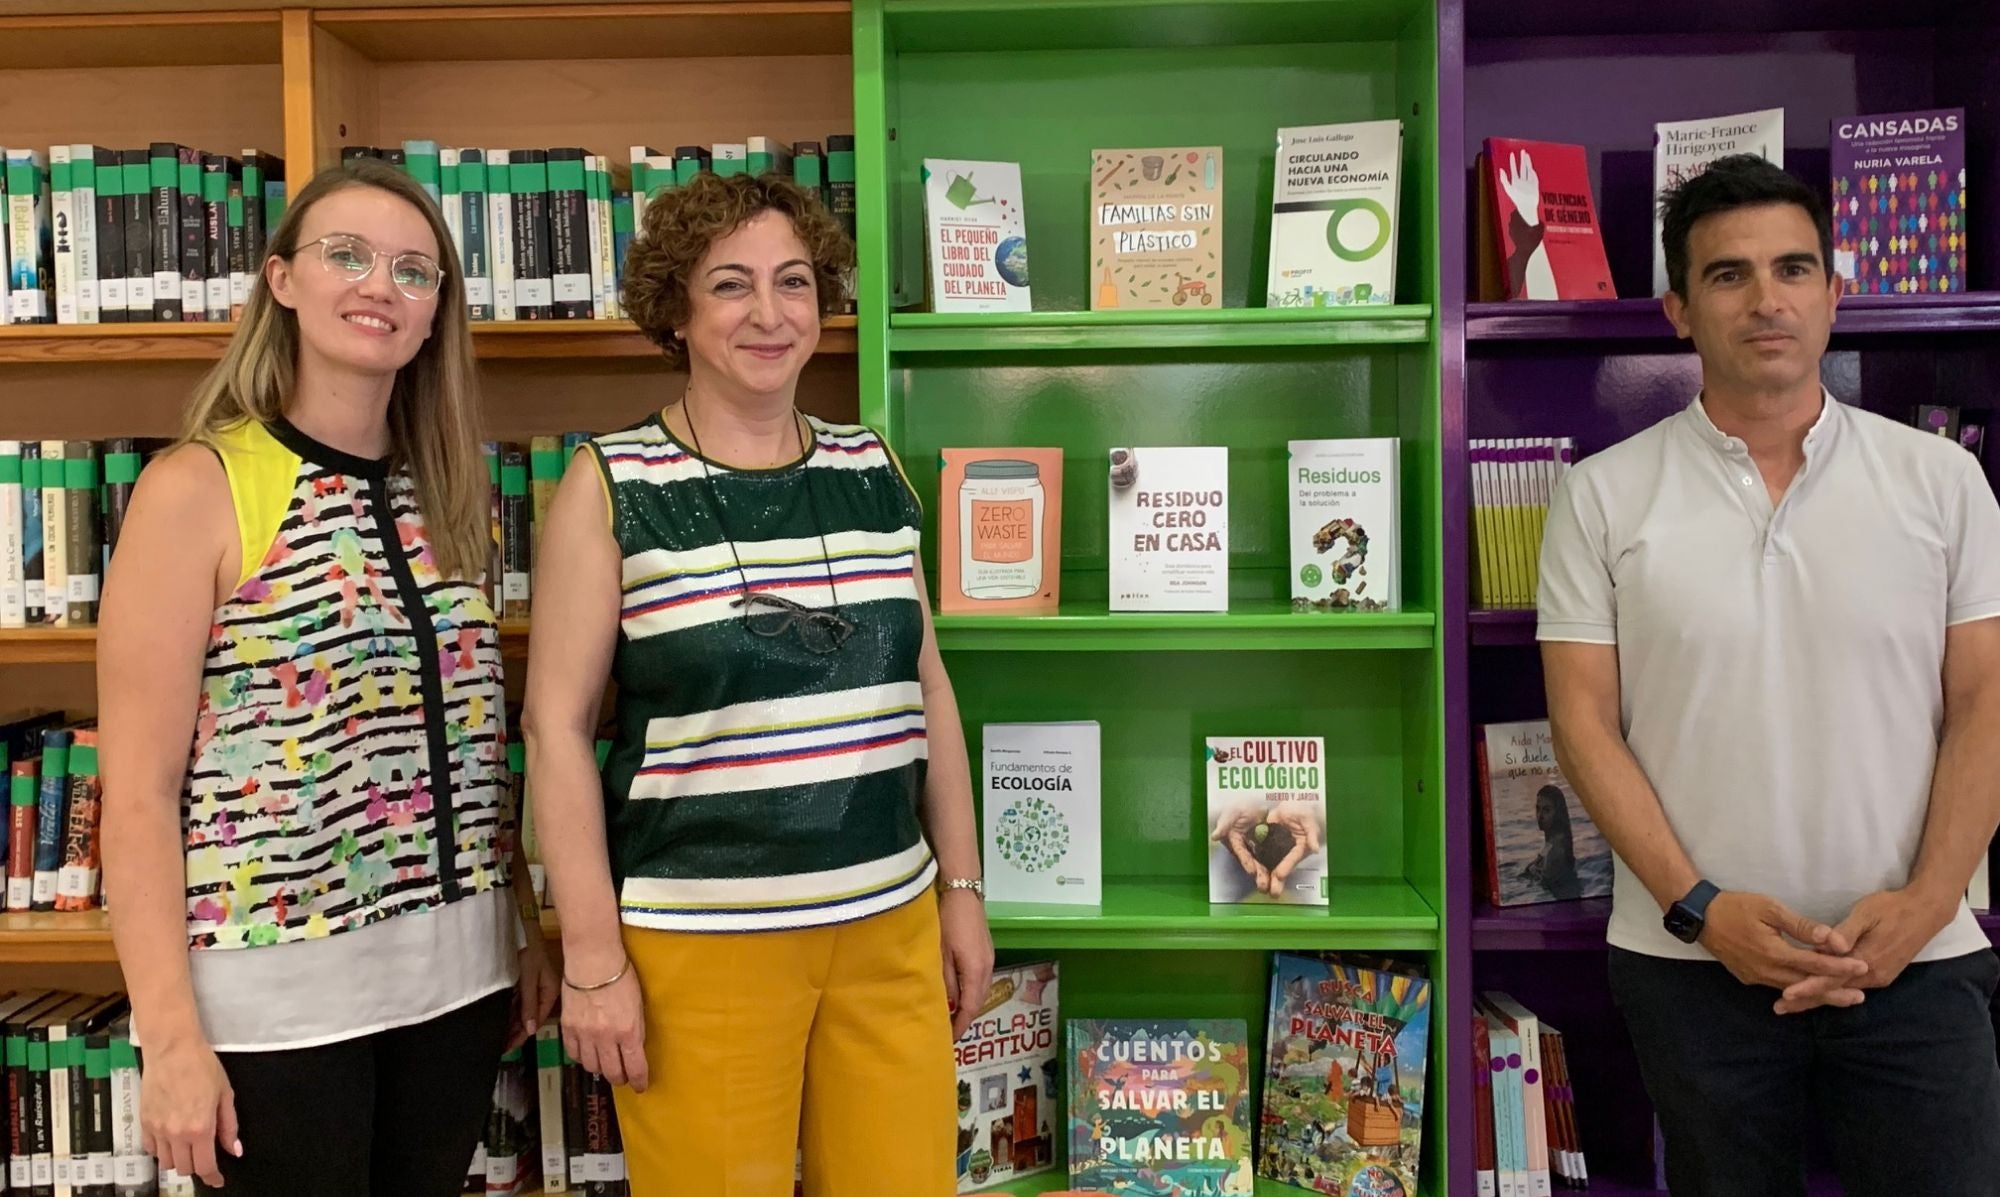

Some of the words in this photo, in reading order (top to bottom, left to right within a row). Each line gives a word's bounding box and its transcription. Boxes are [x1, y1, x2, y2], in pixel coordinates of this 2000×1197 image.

[1666, 123, 1757, 142] Marie-France
[1838, 115, 1959, 139] CANSADAS
[1326, 133, 1354, 142] Gallego
[1666, 140, 1736, 157] Hirigoyen
[1288, 151, 1360, 164] CIRCULANDO
[1854, 157, 1892, 170] NURIA
[1895, 154, 1943, 167] VARELA
[1288, 165, 1321, 175] HACIA
[1323, 163, 1349, 173] UNA
[1287, 176, 1324, 187] NUEVA
[1327, 170, 1390, 184] ECONOMÍA
[1541, 191, 1588, 208] VIOLENCIAS
[1102, 202, 1176, 224] FAMILIAS
[1183, 205, 1210, 221] SIN
[1544, 207, 1556, 223] DE
[1556, 207, 1592, 224] GÉNERO
[940, 229, 952, 243] EL
[955, 228, 998, 245] PEQUEÑO
[1120, 228, 1192, 253] PLÁSTICO
[942, 246, 970, 260] LIBRO
[973, 247, 991, 261] DEL
[943, 263, 984, 277] CUIDADO
[944, 280, 962, 294] DEL
[965, 281, 1006, 295] PLANETA
[1298, 467, 1381, 484] Residuos
[1136, 490, 1223, 508] RESIDUO
[1299, 489, 1311, 497] Del
[1313, 489, 1349, 499] problema
[1299, 499, 1306, 507] la
[1308, 498, 1340, 506] solución
[980, 506, 1026, 522] ZERO
[1152, 510, 1206, 528] CERO
[977, 524, 1028, 540] WASTE
[1134, 534, 1160, 552] EN
[1166, 532, 1222, 552] CASA
[8, 564, 16, 582] John
[1510, 731, 1532, 746] Aida
[1230, 747, 1242, 760] EL
[1243, 740, 1318, 764] CULTIVO
[1504, 752, 1517, 765] Si
[1521, 746, 1550, 763] duele
[990, 761, 1056, 773] Fundamentos
[1058, 764, 1073, 773] de
[1508, 767, 1528, 780] que
[1531, 766, 1543, 776] no
[991, 775, 1072, 791] ECOLOGÍA
[1218, 764, 1319, 789] ECOLÓGICO
[1265, 792, 1289, 801] HUERTO
[1291, 792, 1295, 801] Y
[1318, 979, 1373, 1005] BUSCA
[1303, 999, 1365, 1025] SALVAR
[1367, 1012, 1386, 1031] EL
[1289, 1016, 1398, 1058] PLANETA
[1096, 1040, 1222, 1062] CUENTOS
[1142, 1068, 1179, 1081] PARA
[1098, 1089, 1189, 1111] SALVAR
[1197, 1089, 1224, 1110] EL
[1099, 1136, 1226, 1160] PLANETA
